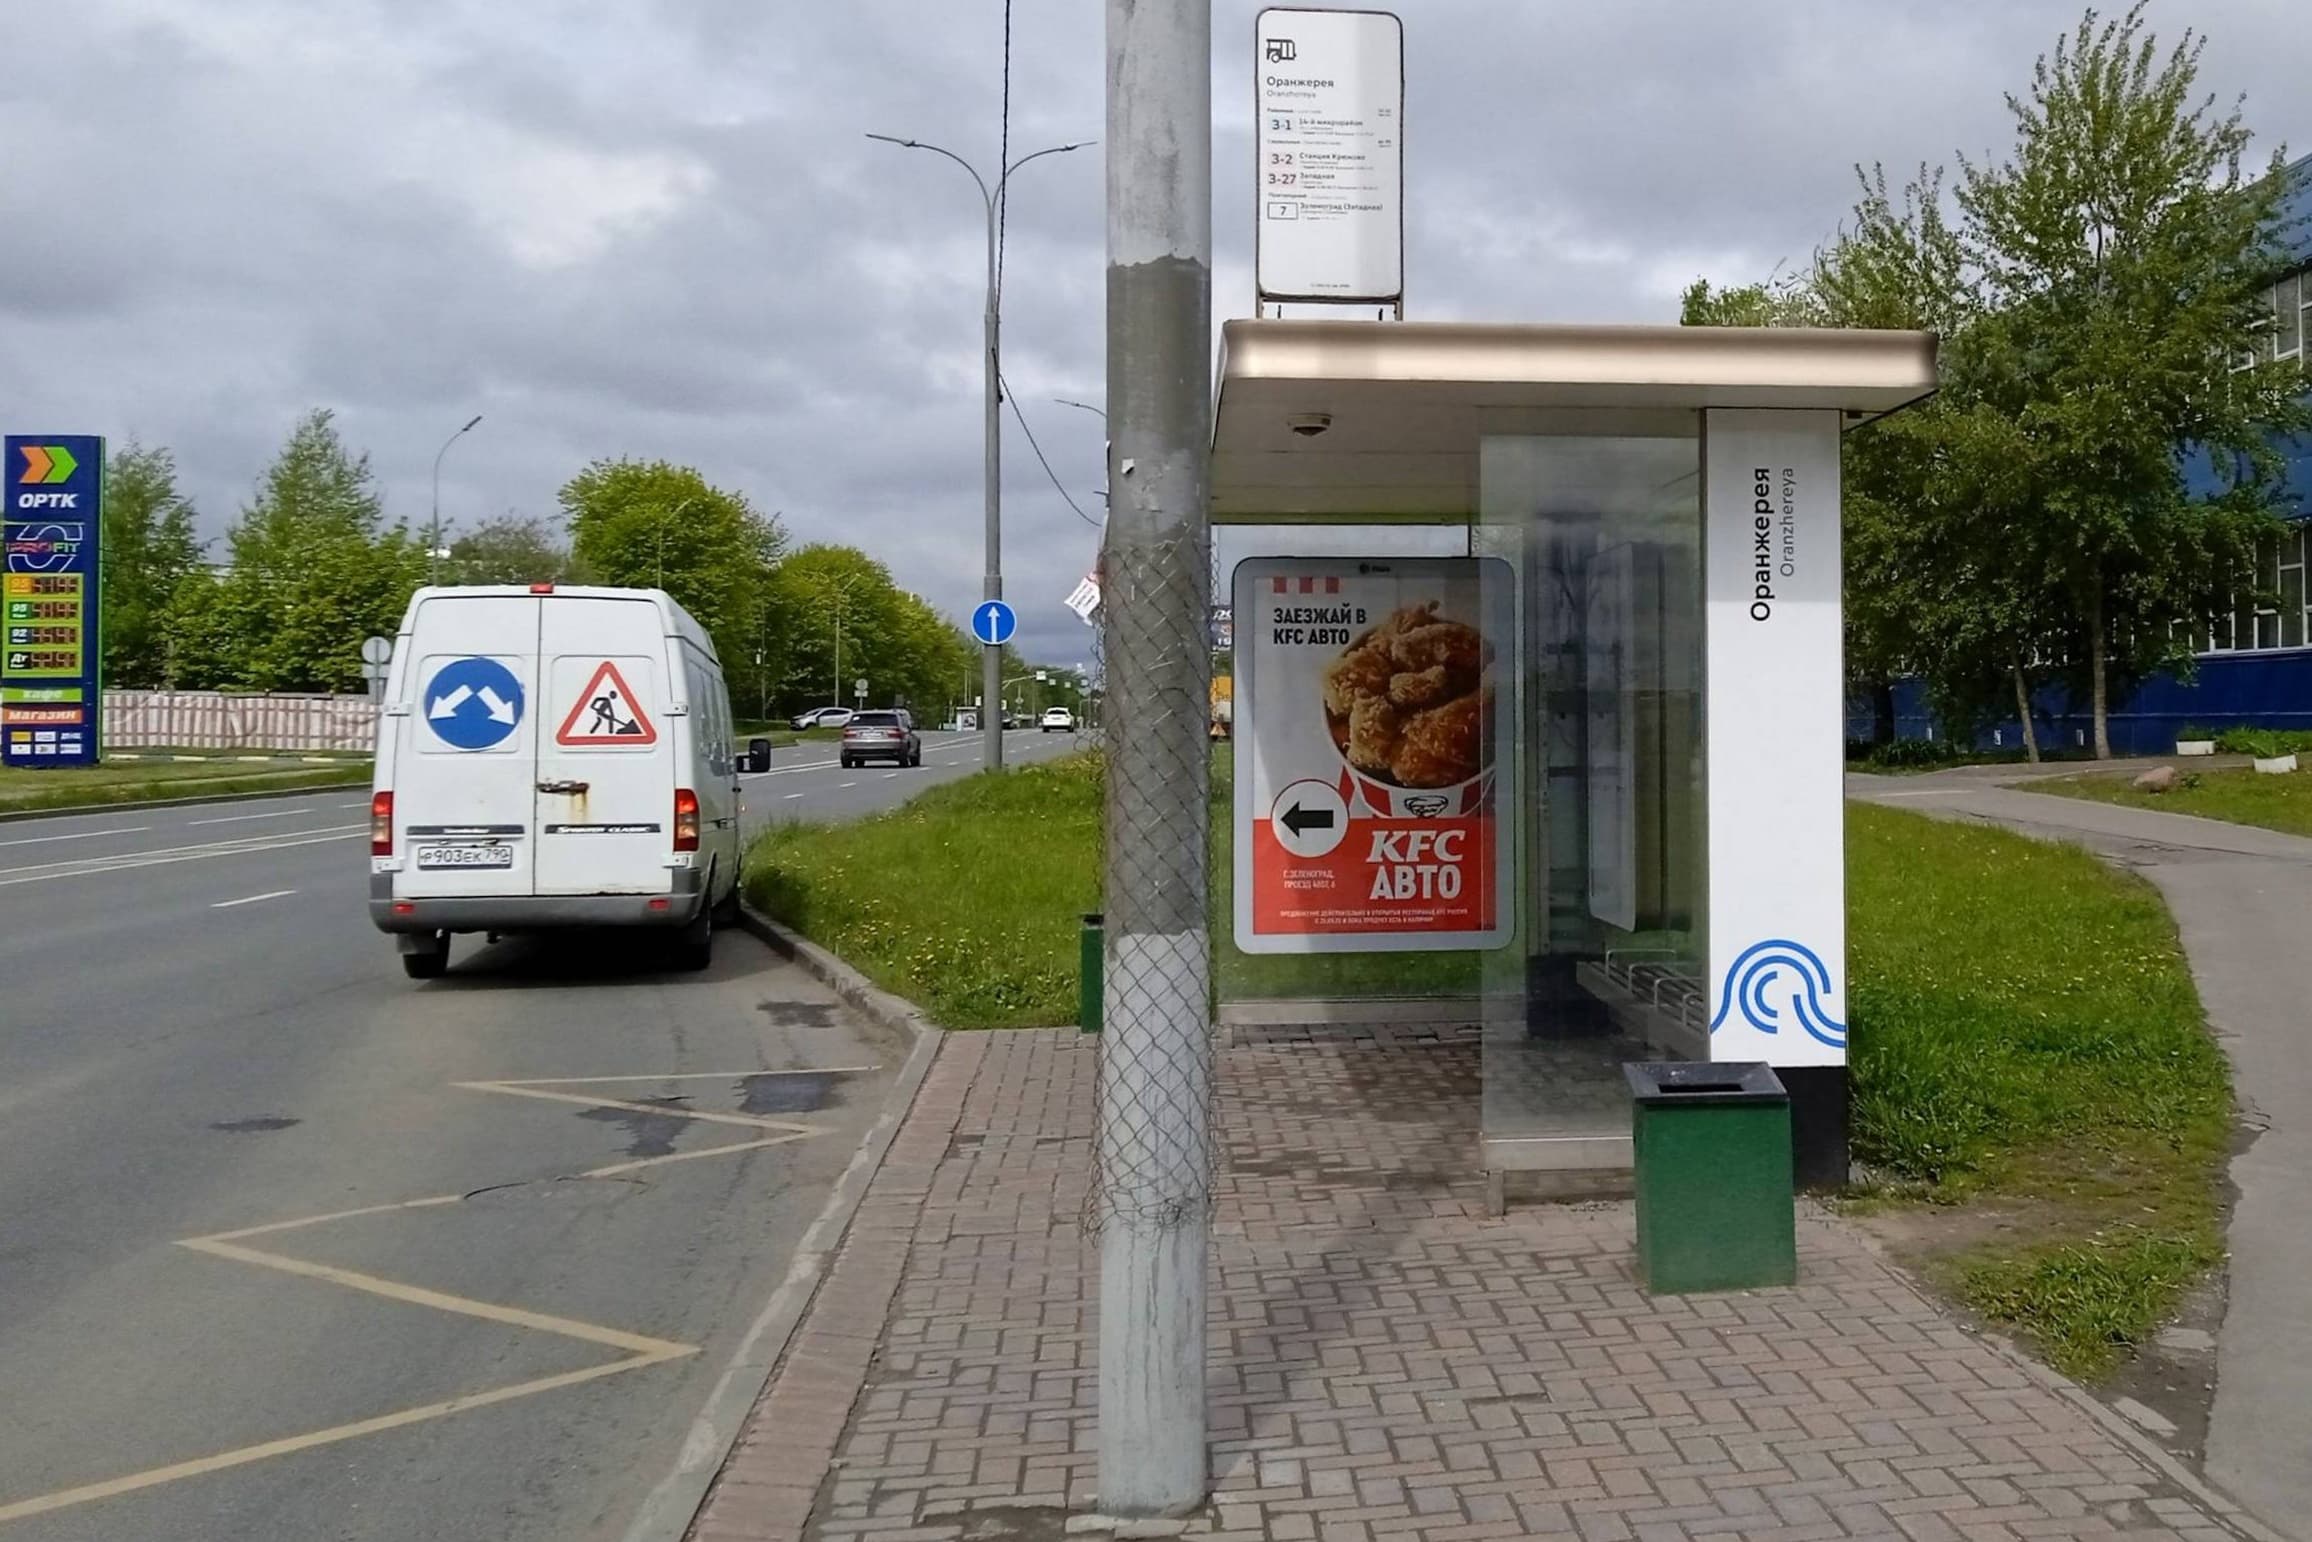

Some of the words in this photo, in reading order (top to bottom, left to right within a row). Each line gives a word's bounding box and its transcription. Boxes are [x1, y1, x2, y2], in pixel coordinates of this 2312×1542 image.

[1266, 75, 1335, 89] Оранжерея
[1279, 206, 1287, 217] 7
[1779, 467, 1797, 577] Oranzhereya
[1750, 467, 1775, 622] Оранжерея
[1273, 602, 1352, 624] ЗАЕЗЖАЙ
[1356, 608, 1367, 624] В
[1273, 628, 1304, 645] KFC
[1307, 628, 1350, 645] АВТО
[1366, 830, 1466, 863] KFC
[1369, 864, 1461, 900] АВТО
